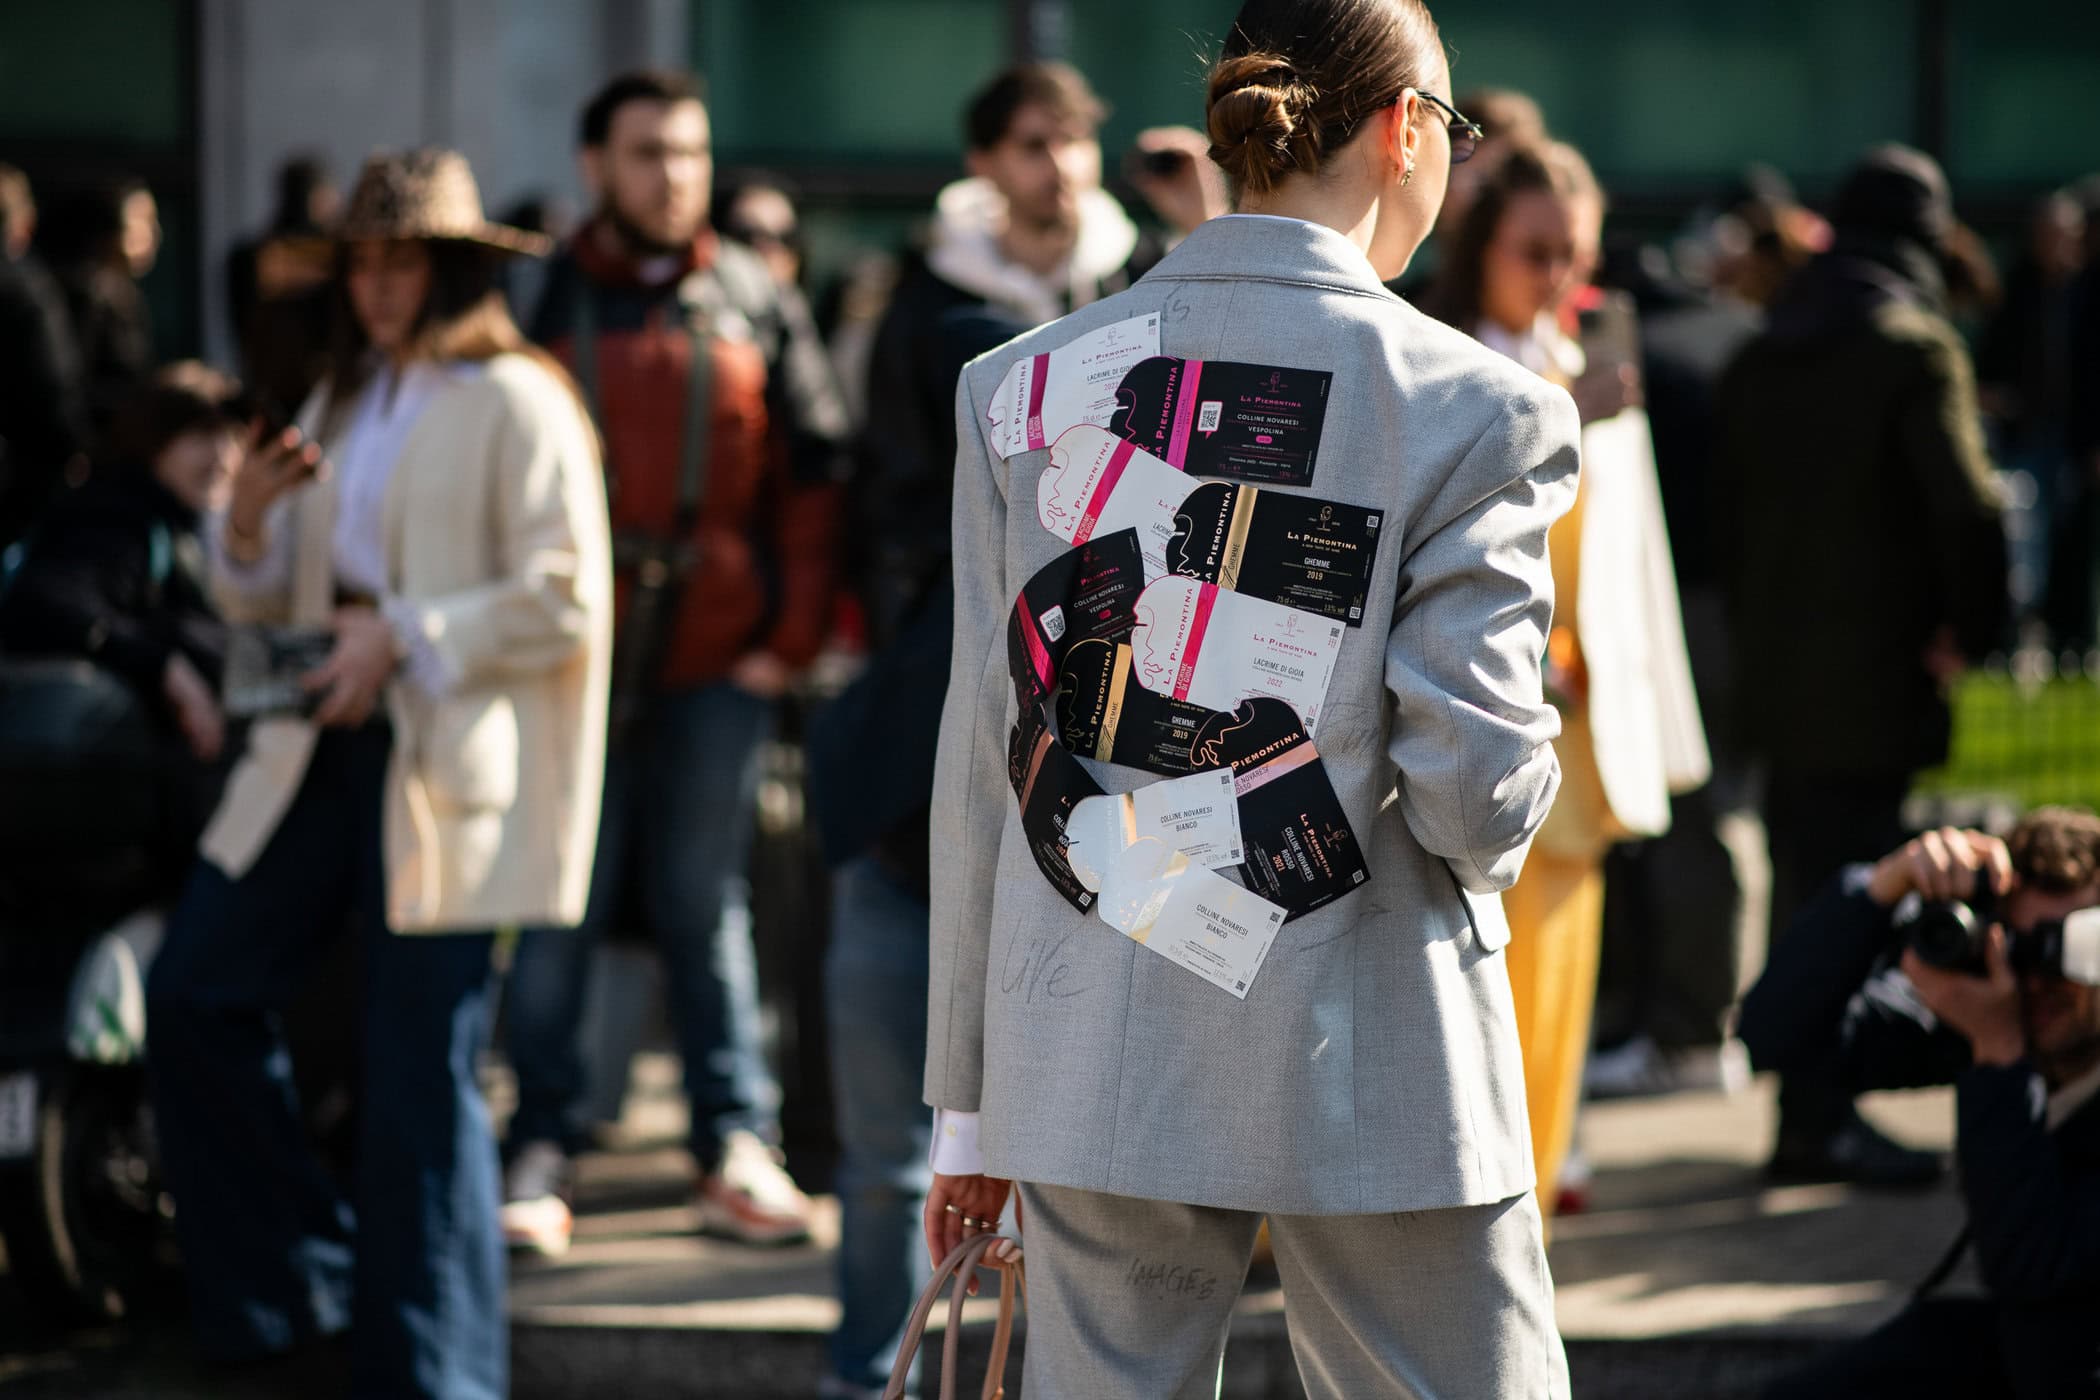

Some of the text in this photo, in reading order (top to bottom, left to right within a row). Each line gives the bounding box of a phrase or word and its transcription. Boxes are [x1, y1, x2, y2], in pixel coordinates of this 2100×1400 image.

[1096, 345, 1143, 361] PIEMONTINA
[1087, 369, 1111, 382] LACRIME
[1015, 364, 1027, 425] PIEMONTINA
[1156, 366, 1178, 440] PIEMONTINA
[1240, 395, 1252, 403] LA
[1255, 396, 1302, 408] PIEMONTINA
[1237, 413, 1265, 422] COLLINE
[1266, 416, 1299, 426] NOVARESI
[1248, 426, 1284, 435] VESPOLINA
[1065, 441, 1110, 531] LA PIEMONTINA
[1206, 491, 1232, 565] PIEMONTINA
[1287, 531, 1357, 550] LA PIEMONTINA
[1227, 543, 1241, 570] GHEMME
[1304, 557, 1330, 569] GHEMME
[1306, 570, 1323, 581] 2019
[1073, 583, 1124, 609] COLLINE NOVARESI
[1088, 599, 1115, 614] VESPOLINA
[1164, 588, 1193, 685] LA PIEMONTINA
[1253, 633, 1318, 657] LA PIEMONTINA
[1176, 663, 1187, 689] LACRIME
[1183, 665, 1193, 681] GIOIA
[1253, 657, 1280, 672] LACRIME
[1280, 663, 1288, 673] DI
[1288, 665, 1305, 677] GIOIA
[1267, 677, 1283, 688] 2022
[1085, 651, 1112, 748] LA PIEMONTINA
[1108, 702, 1118, 728] GHEMME
[1171, 715, 1196, 728] GHEMME
[1172, 729, 1188, 739] 2019
[1231, 732, 1300, 770] PIEMONTINA
[1240, 765, 1269, 785] NOVARESI
[1236, 783, 1251, 794] OSSO
[1160, 806, 1213, 824] COLLINE NOVARESI
[1176, 821, 1198, 832] BIANCO
[1284, 826, 1315, 882] COLLINE NOVARESI
[1300, 813, 1309, 827] LA
[1307, 828, 1334, 879] PIEMONTINA
[1272, 854, 1285, 872] 2021
[1281, 848, 1295, 870] ROSSO
[1196, 904, 1249, 937] COLLINE NOVARESI
[1206, 923, 1229, 940] BIANCO
